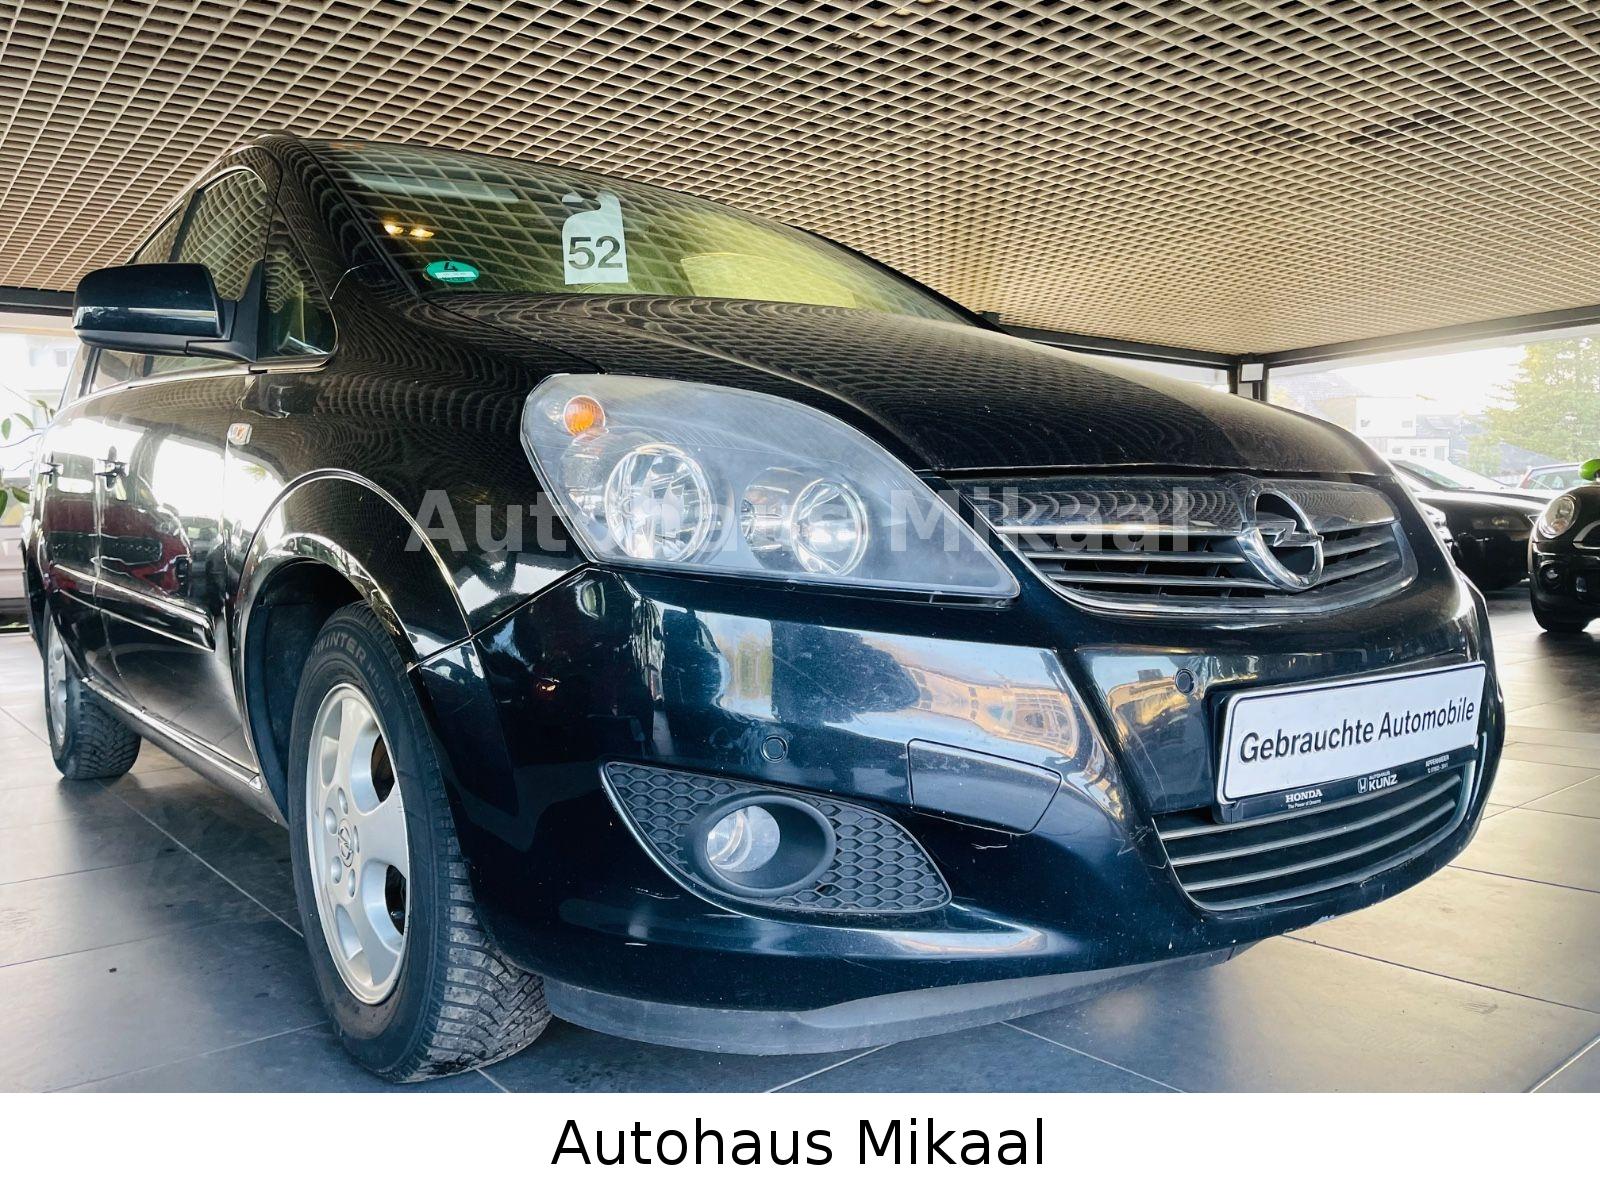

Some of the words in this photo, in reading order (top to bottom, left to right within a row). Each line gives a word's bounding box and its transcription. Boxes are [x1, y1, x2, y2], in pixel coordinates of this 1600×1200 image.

[568, 235, 623, 270] 52
[1239, 718, 1374, 763] Gebrauchte
[1377, 696, 1475, 741] Automobile
[1285, 788, 1323, 803] HONDA
[1369, 774, 1398, 791] KUNZ
